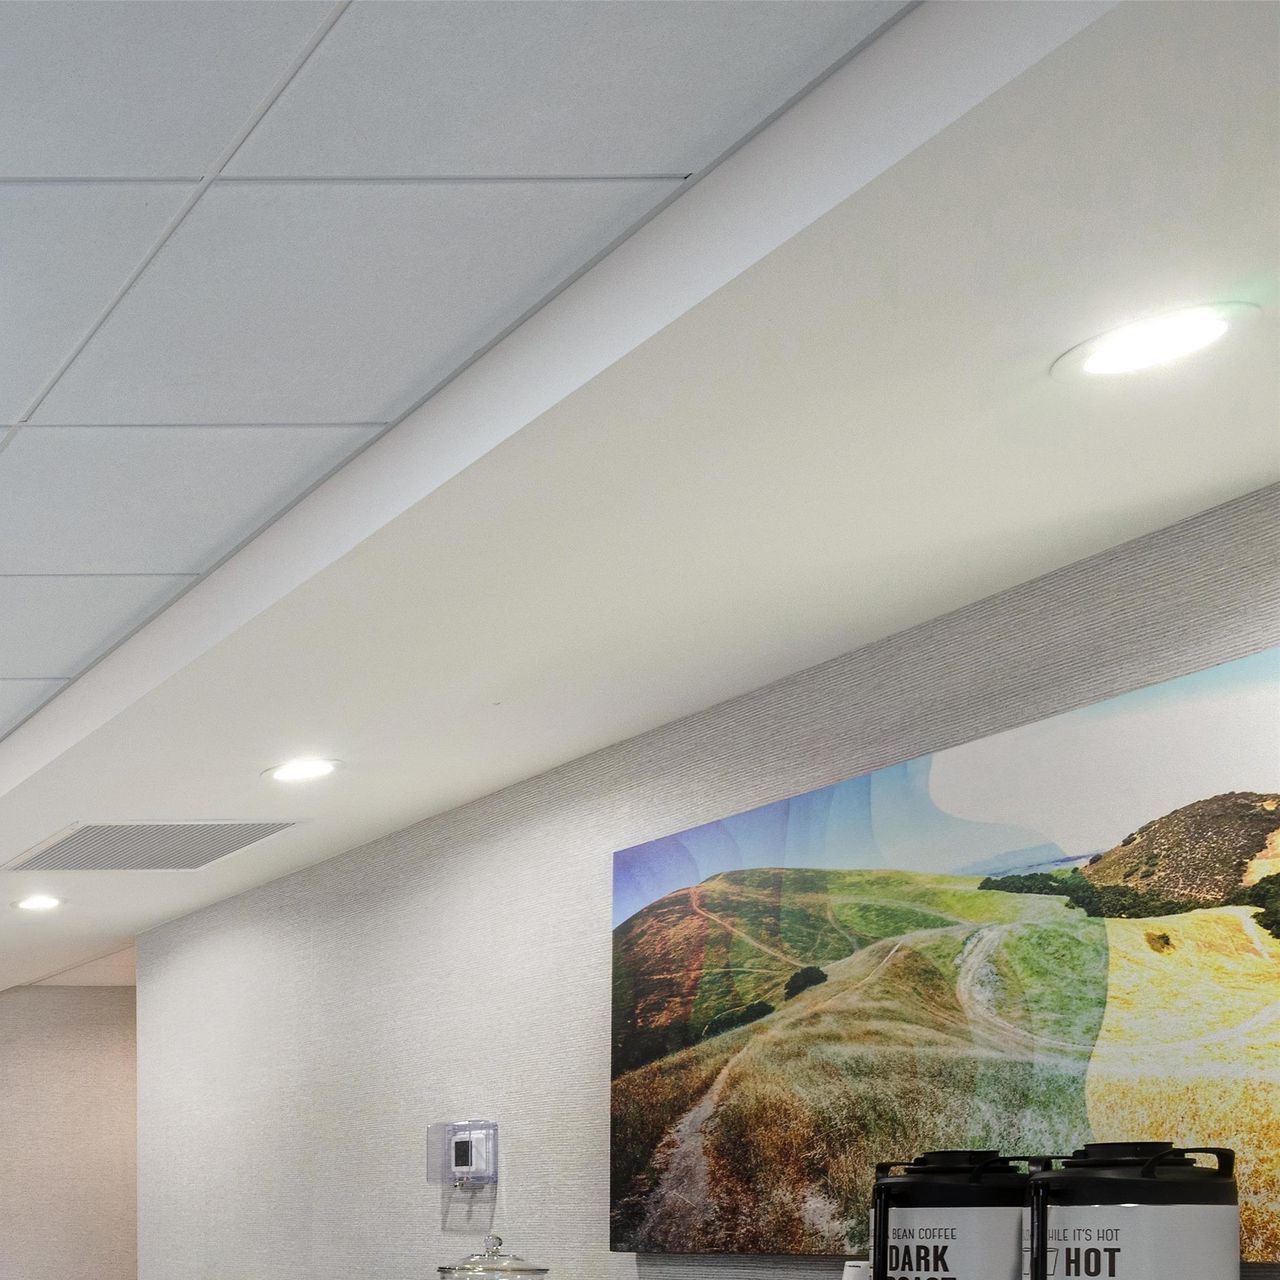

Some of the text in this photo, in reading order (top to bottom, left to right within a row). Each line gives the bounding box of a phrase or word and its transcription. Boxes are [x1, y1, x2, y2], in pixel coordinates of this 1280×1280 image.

[892, 1228, 957, 1240] BEAN COFFEE
[1048, 1229, 1120, 1242] HILE IT'S HOT
[889, 1245, 949, 1272] DARK
[1065, 1247, 1121, 1277] HOT
